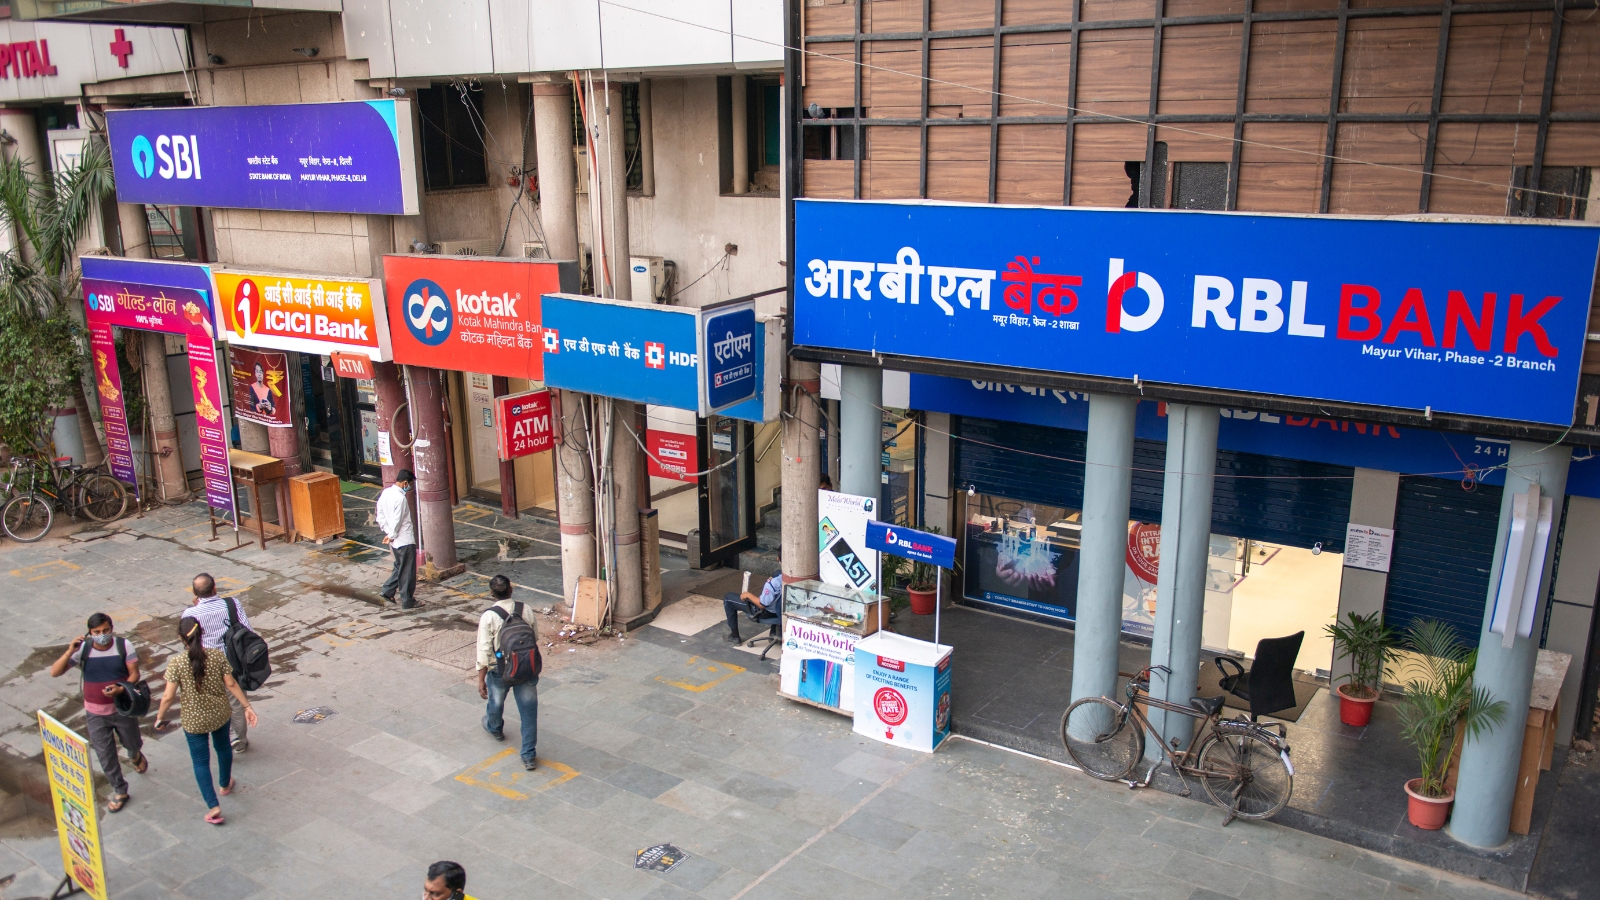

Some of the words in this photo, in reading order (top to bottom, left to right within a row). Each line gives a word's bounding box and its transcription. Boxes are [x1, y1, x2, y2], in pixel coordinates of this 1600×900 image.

[156, 134, 202, 180] SBI
[280, 173, 292, 181] INDIA
[1001, 255, 1083, 316] बैंक
[98, 294, 115, 313] SBI
[264, 281, 281, 306] आई
[281, 281, 293, 304] सी
[294, 283, 312, 309] आई
[313, 283, 325, 307] सी
[325, 286, 345, 312] आई
[345, 285, 362, 310] बैंक
[264, 309, 312, 334] ICICI
[314, 314, 369, 341] Bank
[457, 314, 482, 327] Kotak
[484, 316, 523, 332] Mahindra
[992, 314, 1008, 328] मयूर
[1059, 319, 1080, 330] शाखा
[1191, 274, 1326, 338] RBL
[1336, 282, 1565, 358] BANK
[459, 328, 485, 345] कोटक
[486, 330, 515, 349] महिन्द्रा
[517, 333, 533, 349] बैंक
[563, 338, 577, 352] एच
[578, 336, 590, 353] डी
[591, 342, 606, 357] एफ
[607, 341, 620, 357] सी
[623, 342, 641, 360] बैंक
[713, 330, 752, 365] एटीएम
[339, 358, 365, 375] ATM
[1361, 344, 1402, 362] Mayur
[1404, 347, 1442, 364] Vihar,
[1444, 349, 1485, 367] Phase
[1488, 354, 1503, 367] -2
[1506, 355, 1556, 372] Branch
[521, 401, 538, 410] kotak
[512, 414, 550, 440] ATM
[514, 439, 526, 452] 24
[527, 435, 549, 448] hour
[898, 539, 913, 549] RBL
[912, 542, 933, 554] BANK
[838, 552, 869, 586] A51
[872, 669, 887, 678] ENJOY
[891, 674, 910, 684] RANGE
[881, 662, 900, 670] ACCOUNT
[872, 674, 894, 687] EXCITING
[893, 681, 918, 692] BENEFITS
[41, 726, 65, 753] MOMOS
[65, 742, 87, 769] STALL
